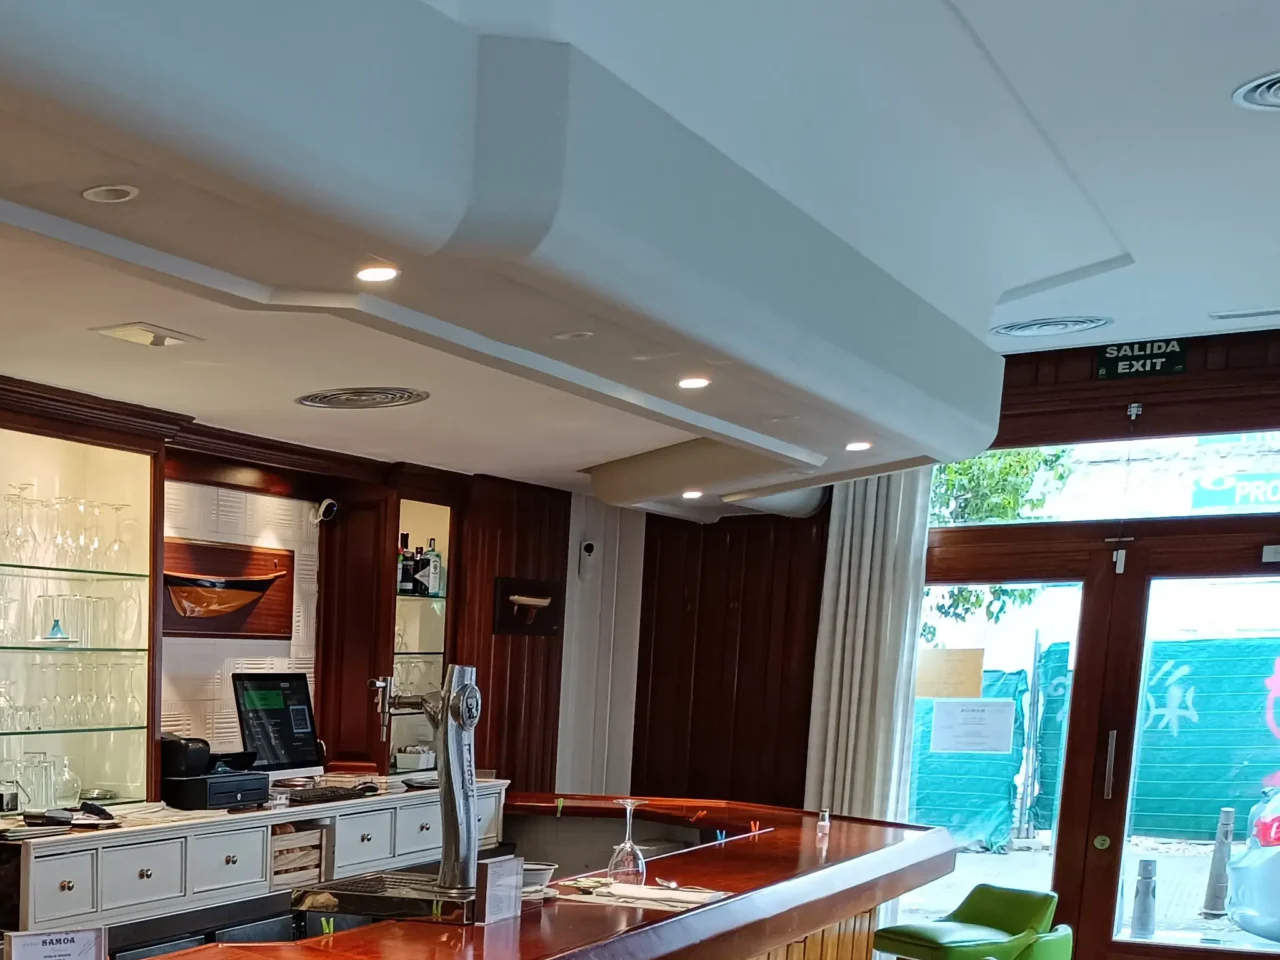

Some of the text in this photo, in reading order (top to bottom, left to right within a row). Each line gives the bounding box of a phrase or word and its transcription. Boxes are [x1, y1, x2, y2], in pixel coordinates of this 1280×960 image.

[1105, 340, 1181, 358] SALIDA
[1117, 358, 1166, 373] EXIT
[41, 937, 76, 947] SAMOA
